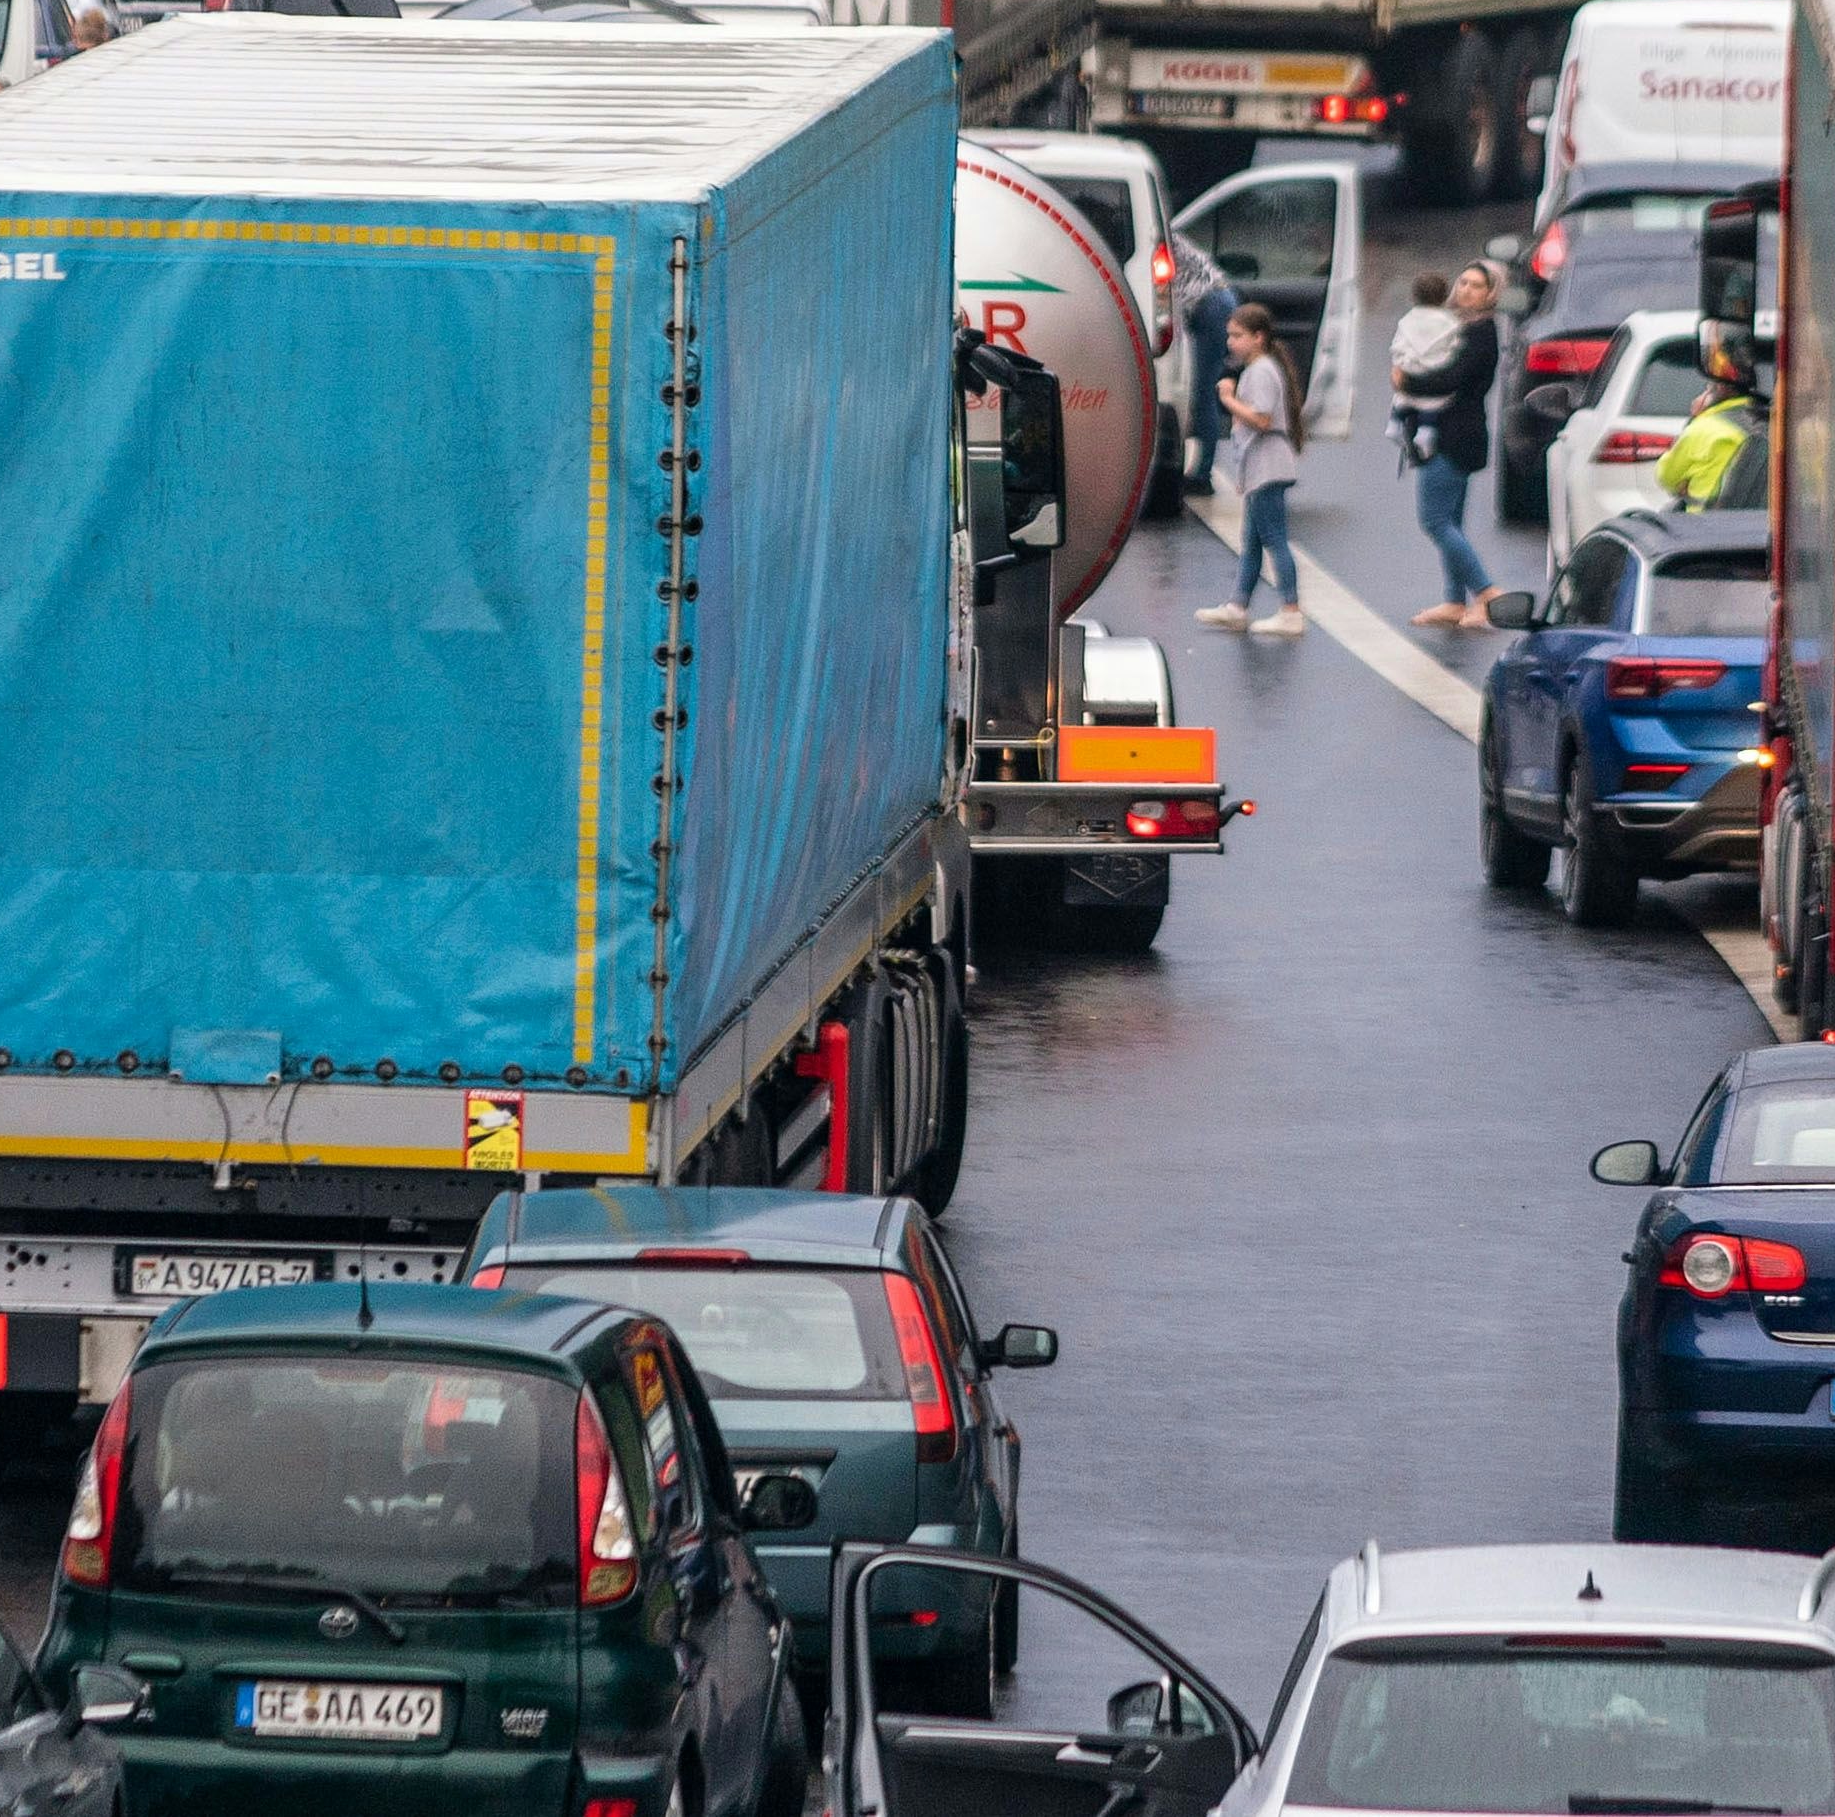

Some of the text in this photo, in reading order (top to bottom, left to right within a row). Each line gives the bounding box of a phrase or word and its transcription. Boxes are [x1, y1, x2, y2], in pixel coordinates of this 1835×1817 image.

[258, 1690, 435, 1727] GE AA 469
